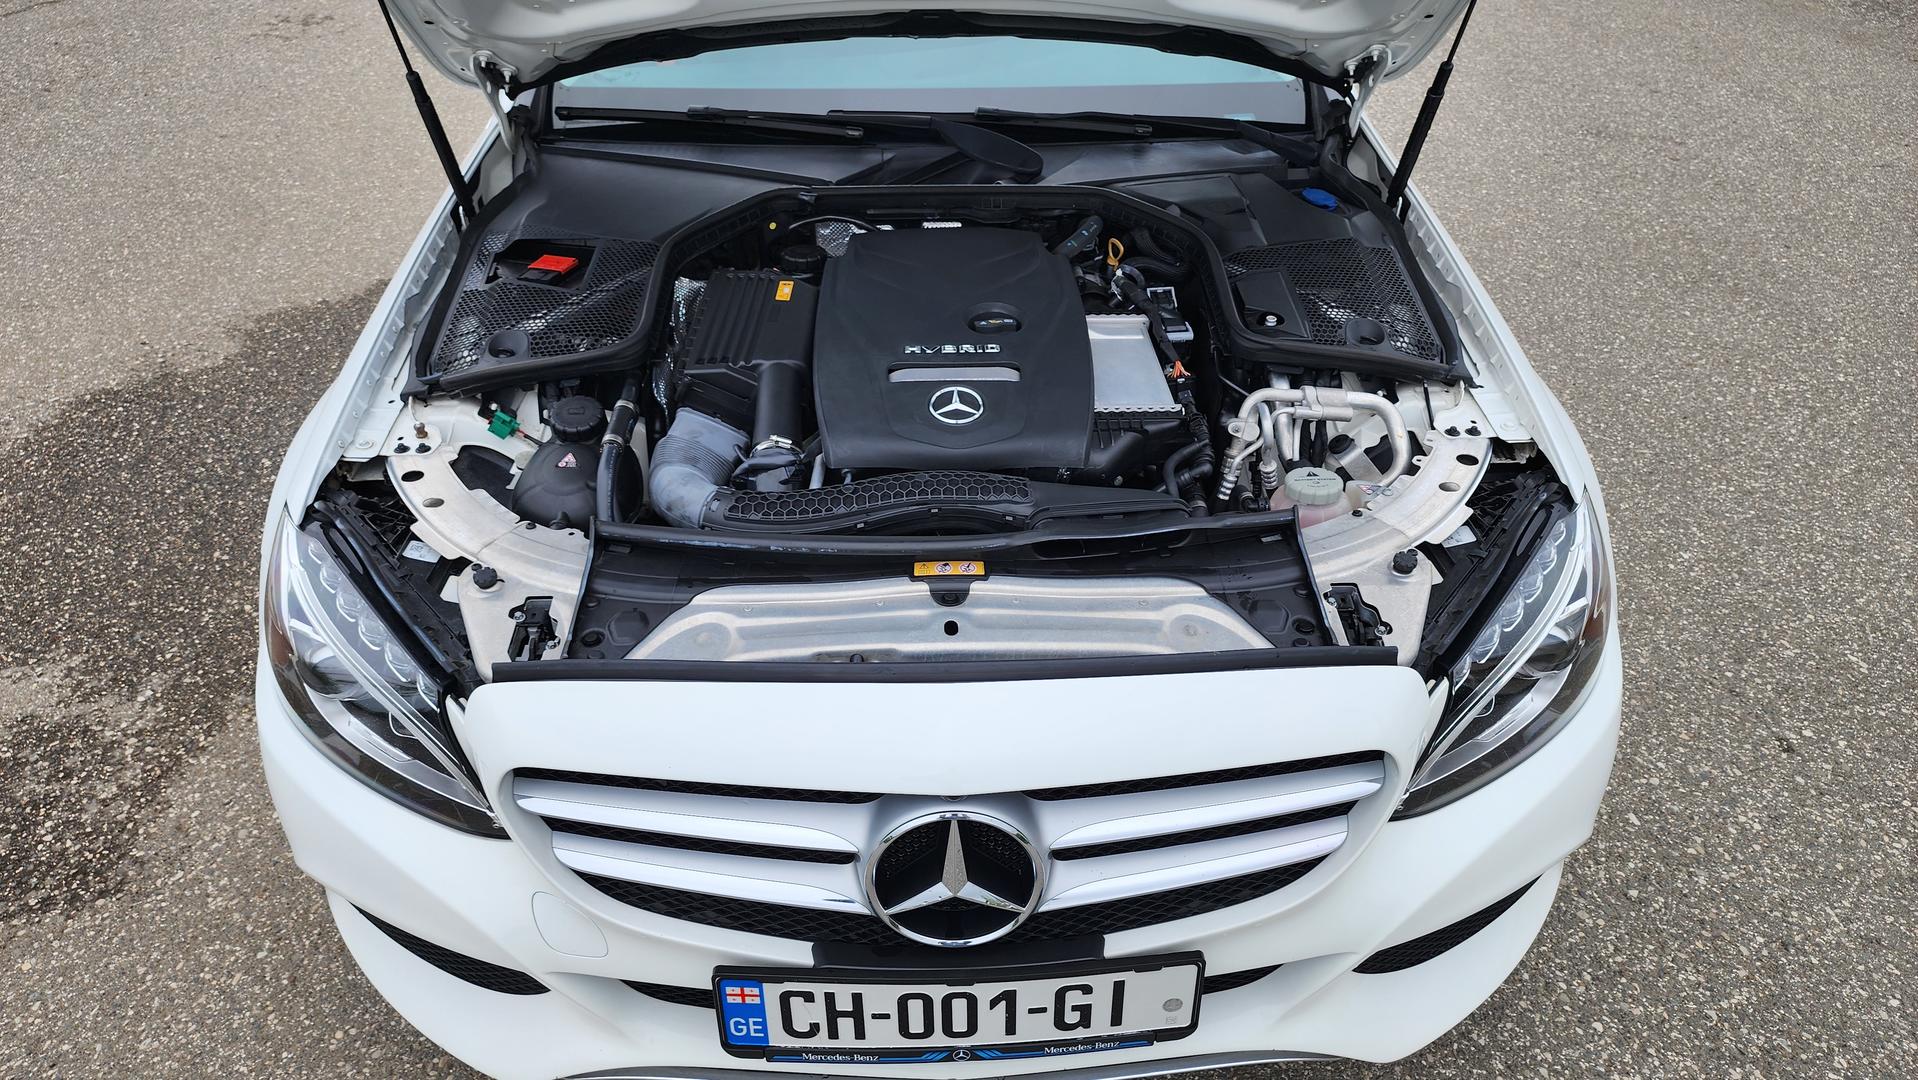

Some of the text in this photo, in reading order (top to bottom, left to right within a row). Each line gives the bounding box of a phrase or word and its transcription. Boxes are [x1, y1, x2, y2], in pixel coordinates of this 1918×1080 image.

[904, 344, 1001, 354] HYBRID
[779, 979, 1126, 1041] CH-001-GI
[729, 1017, 765, 1037] GE
[1044, 1041, 1120, 1055] Mercedes-Benz
[802, 1052, 879, 1062] Mercedes-Benz
